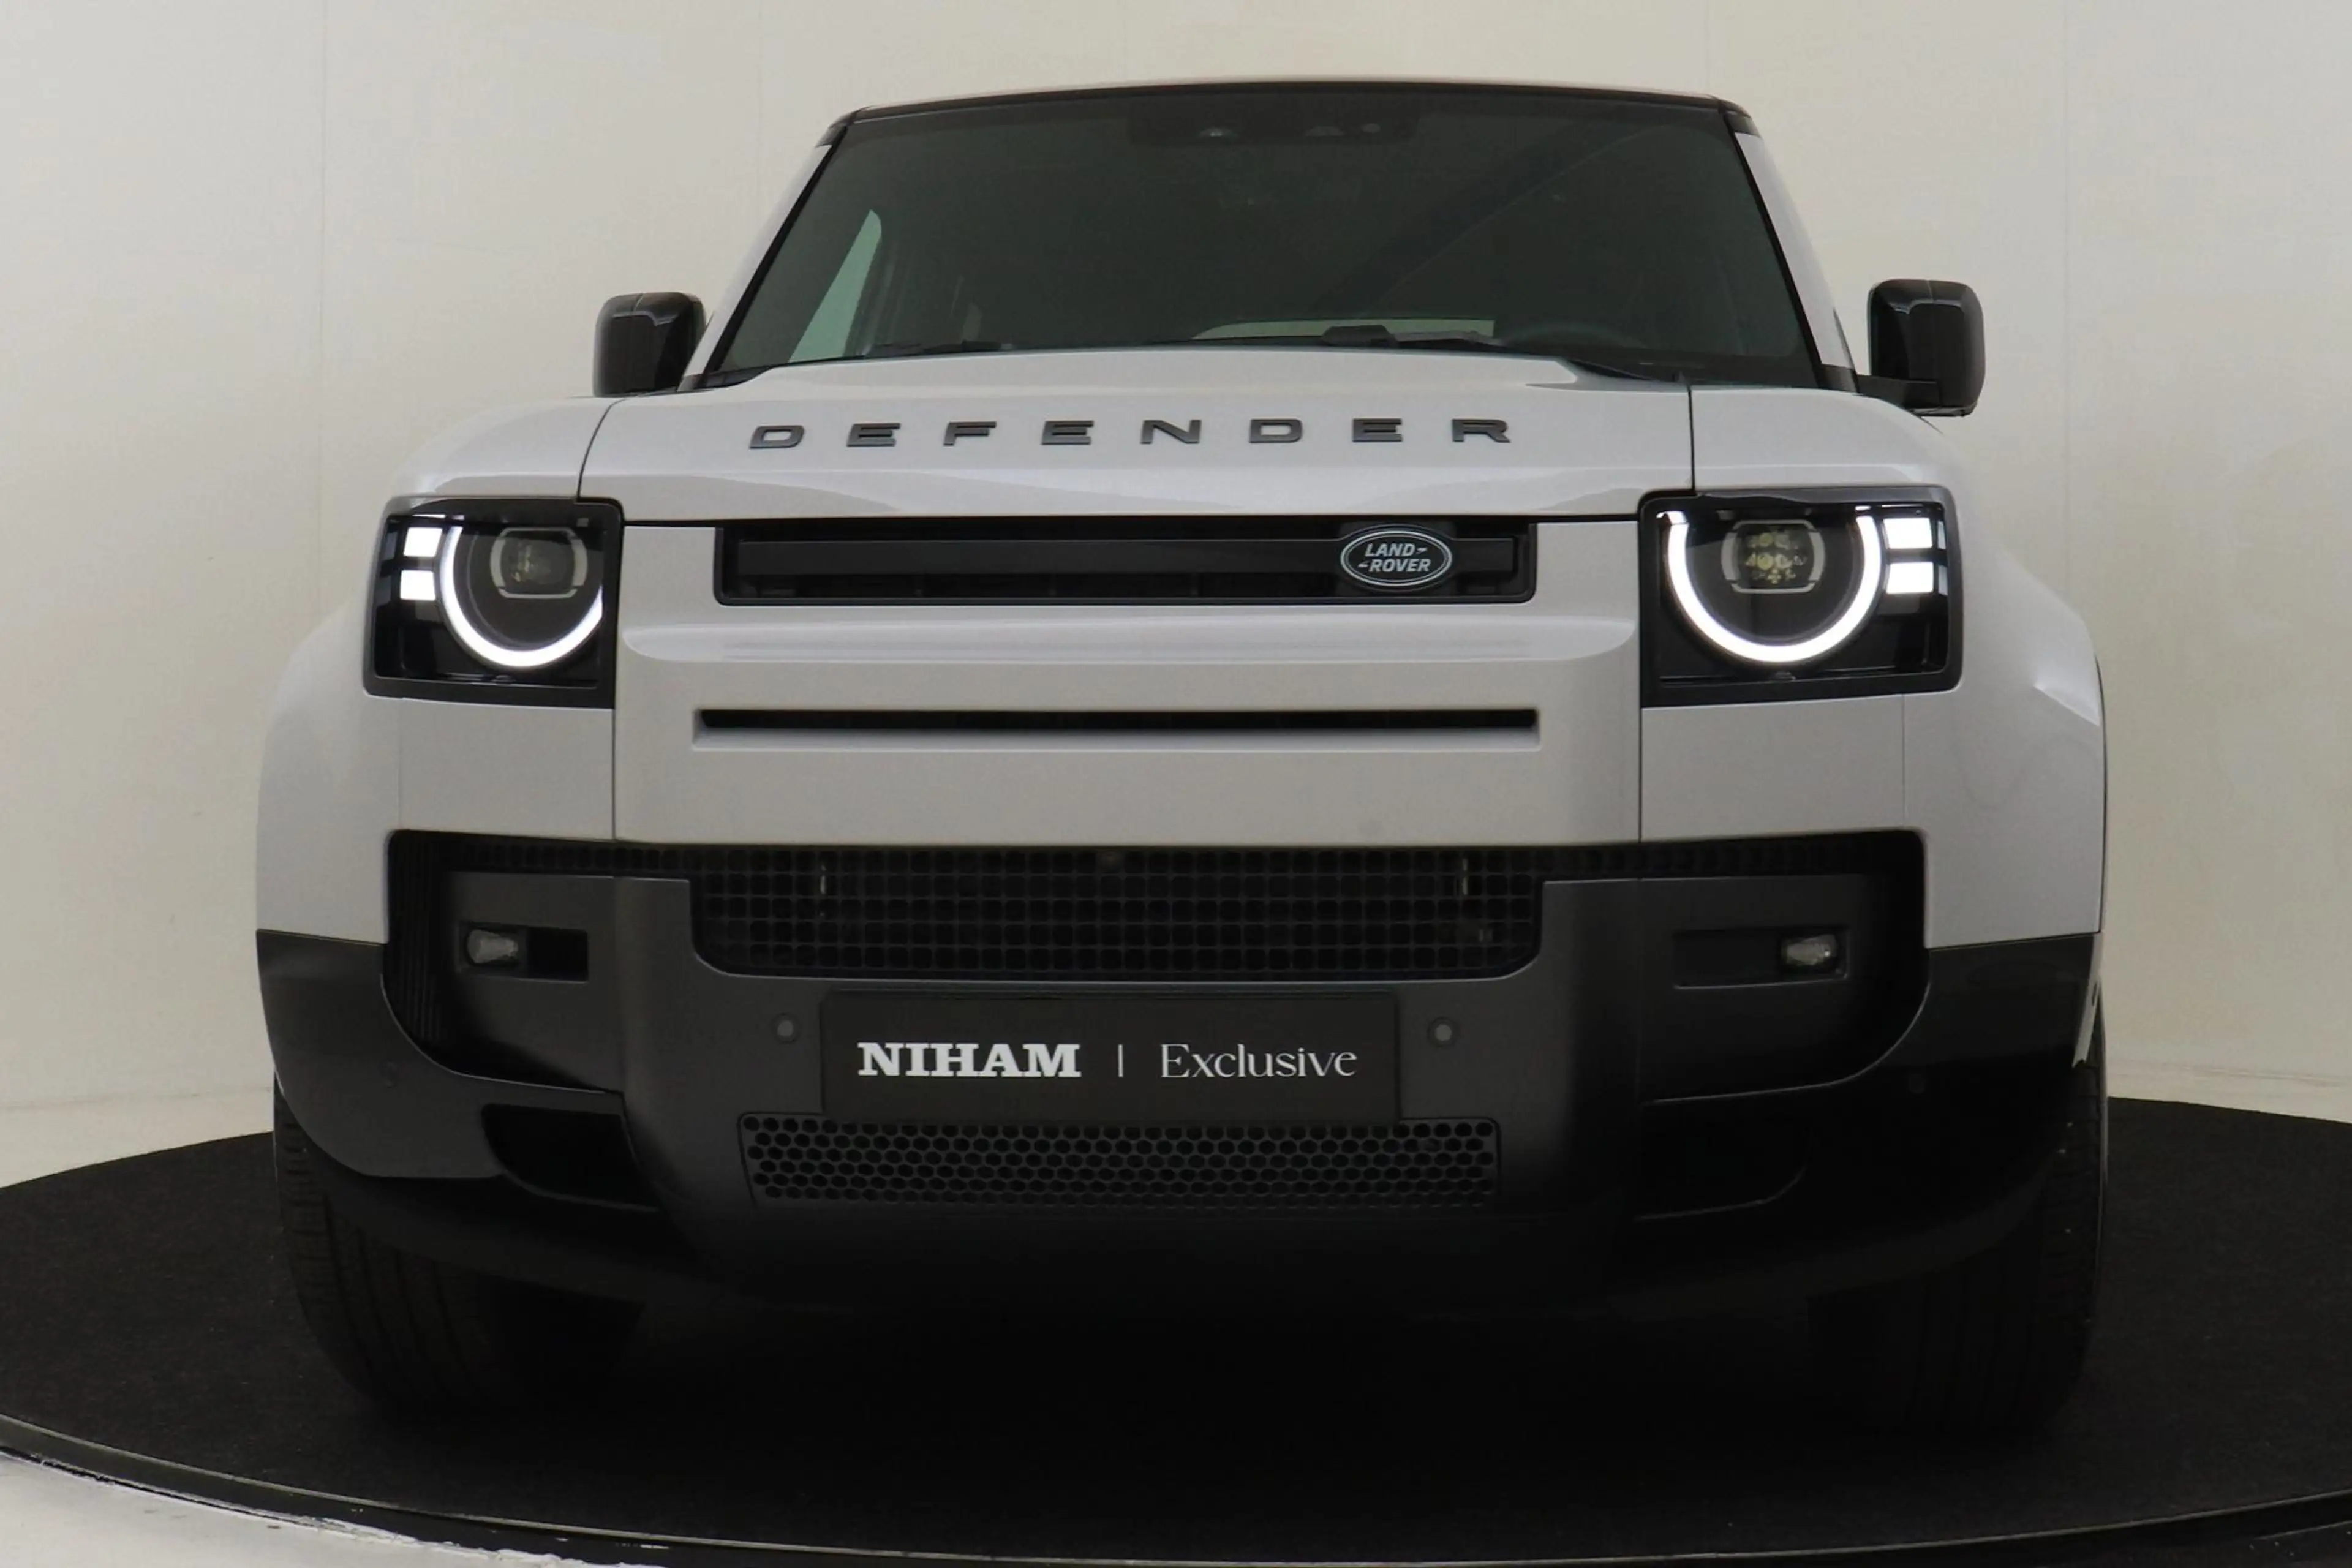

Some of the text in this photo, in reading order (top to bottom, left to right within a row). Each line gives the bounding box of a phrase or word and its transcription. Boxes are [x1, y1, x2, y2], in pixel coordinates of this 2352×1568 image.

[748, 418, 1512, 450] DEFENDER
[858, 1042, 1358, 1079] NIHAM Exclusive
